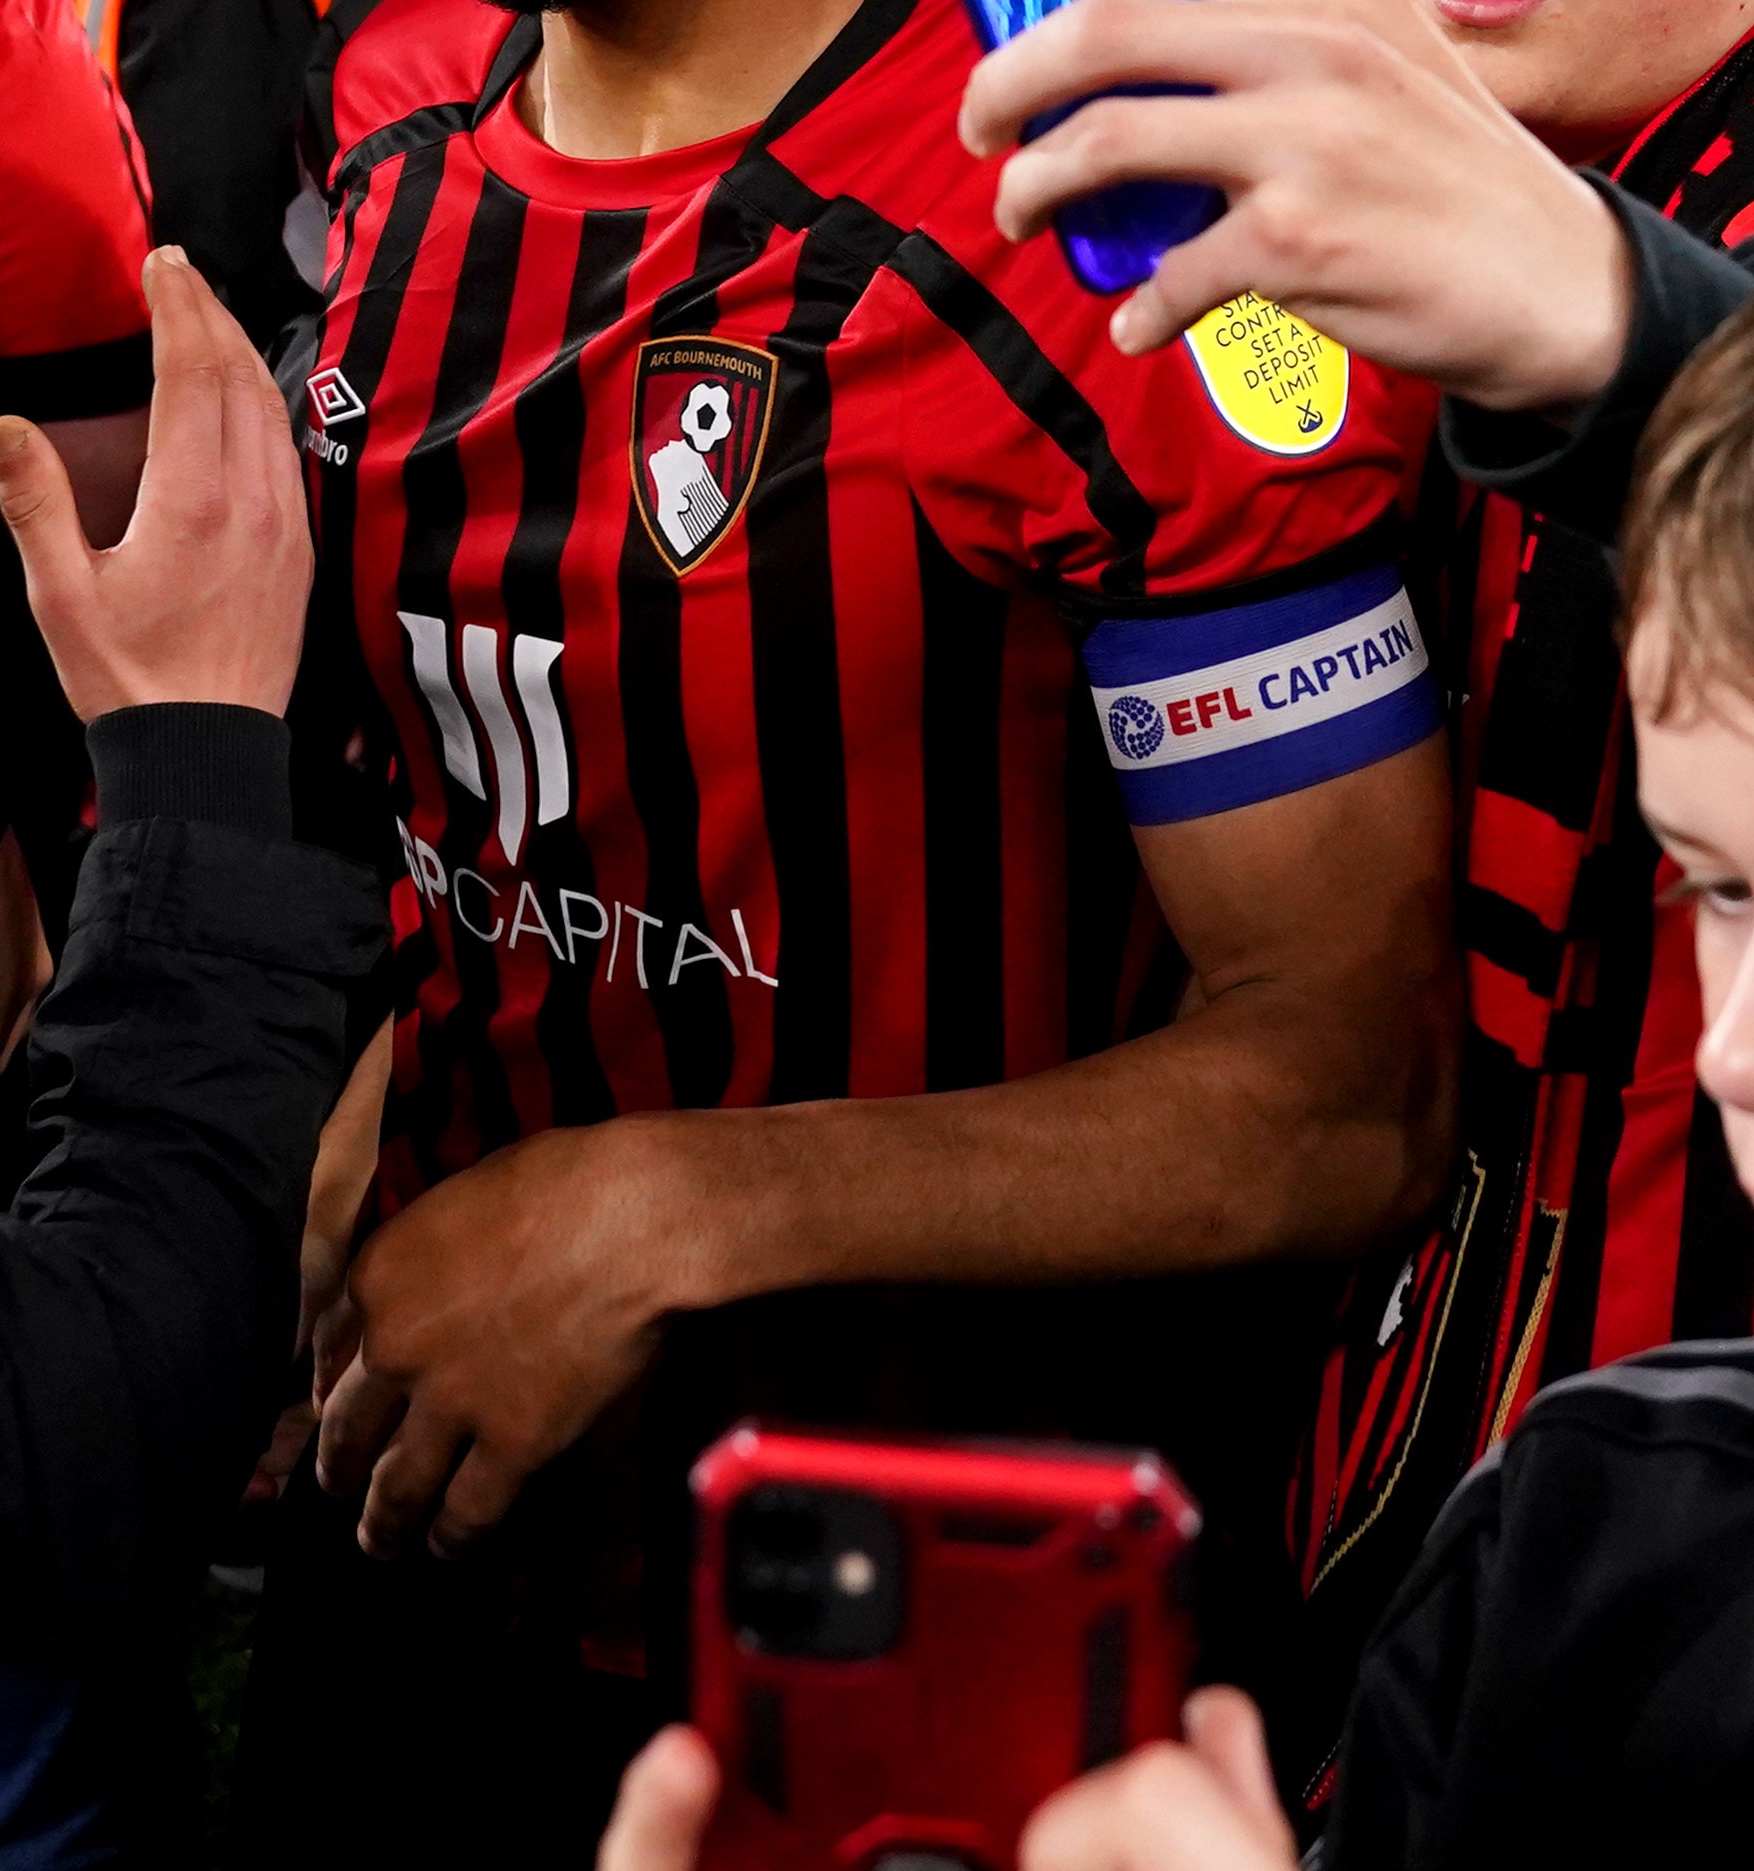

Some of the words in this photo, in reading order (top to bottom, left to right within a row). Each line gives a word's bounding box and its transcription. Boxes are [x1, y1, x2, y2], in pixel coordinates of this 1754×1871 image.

[1215, 302, 1286, 347] CONTR
[1250, 327, 1284, 359] SET
[1290, 322, 1304, 341] A
[649, 351, 673, 368] AFC
[673, 350, 763, 381] BOURNEMOUTH
[1243, 334, 1324, 390] DEPOSIT
[1268, 364, 1320, 405] LIMIT
[1165, 686, 1253, 737] EFL
[1257, 618, 1415, 711] CAPTAIN
[452, 867, 779, 990] CAPITAL
